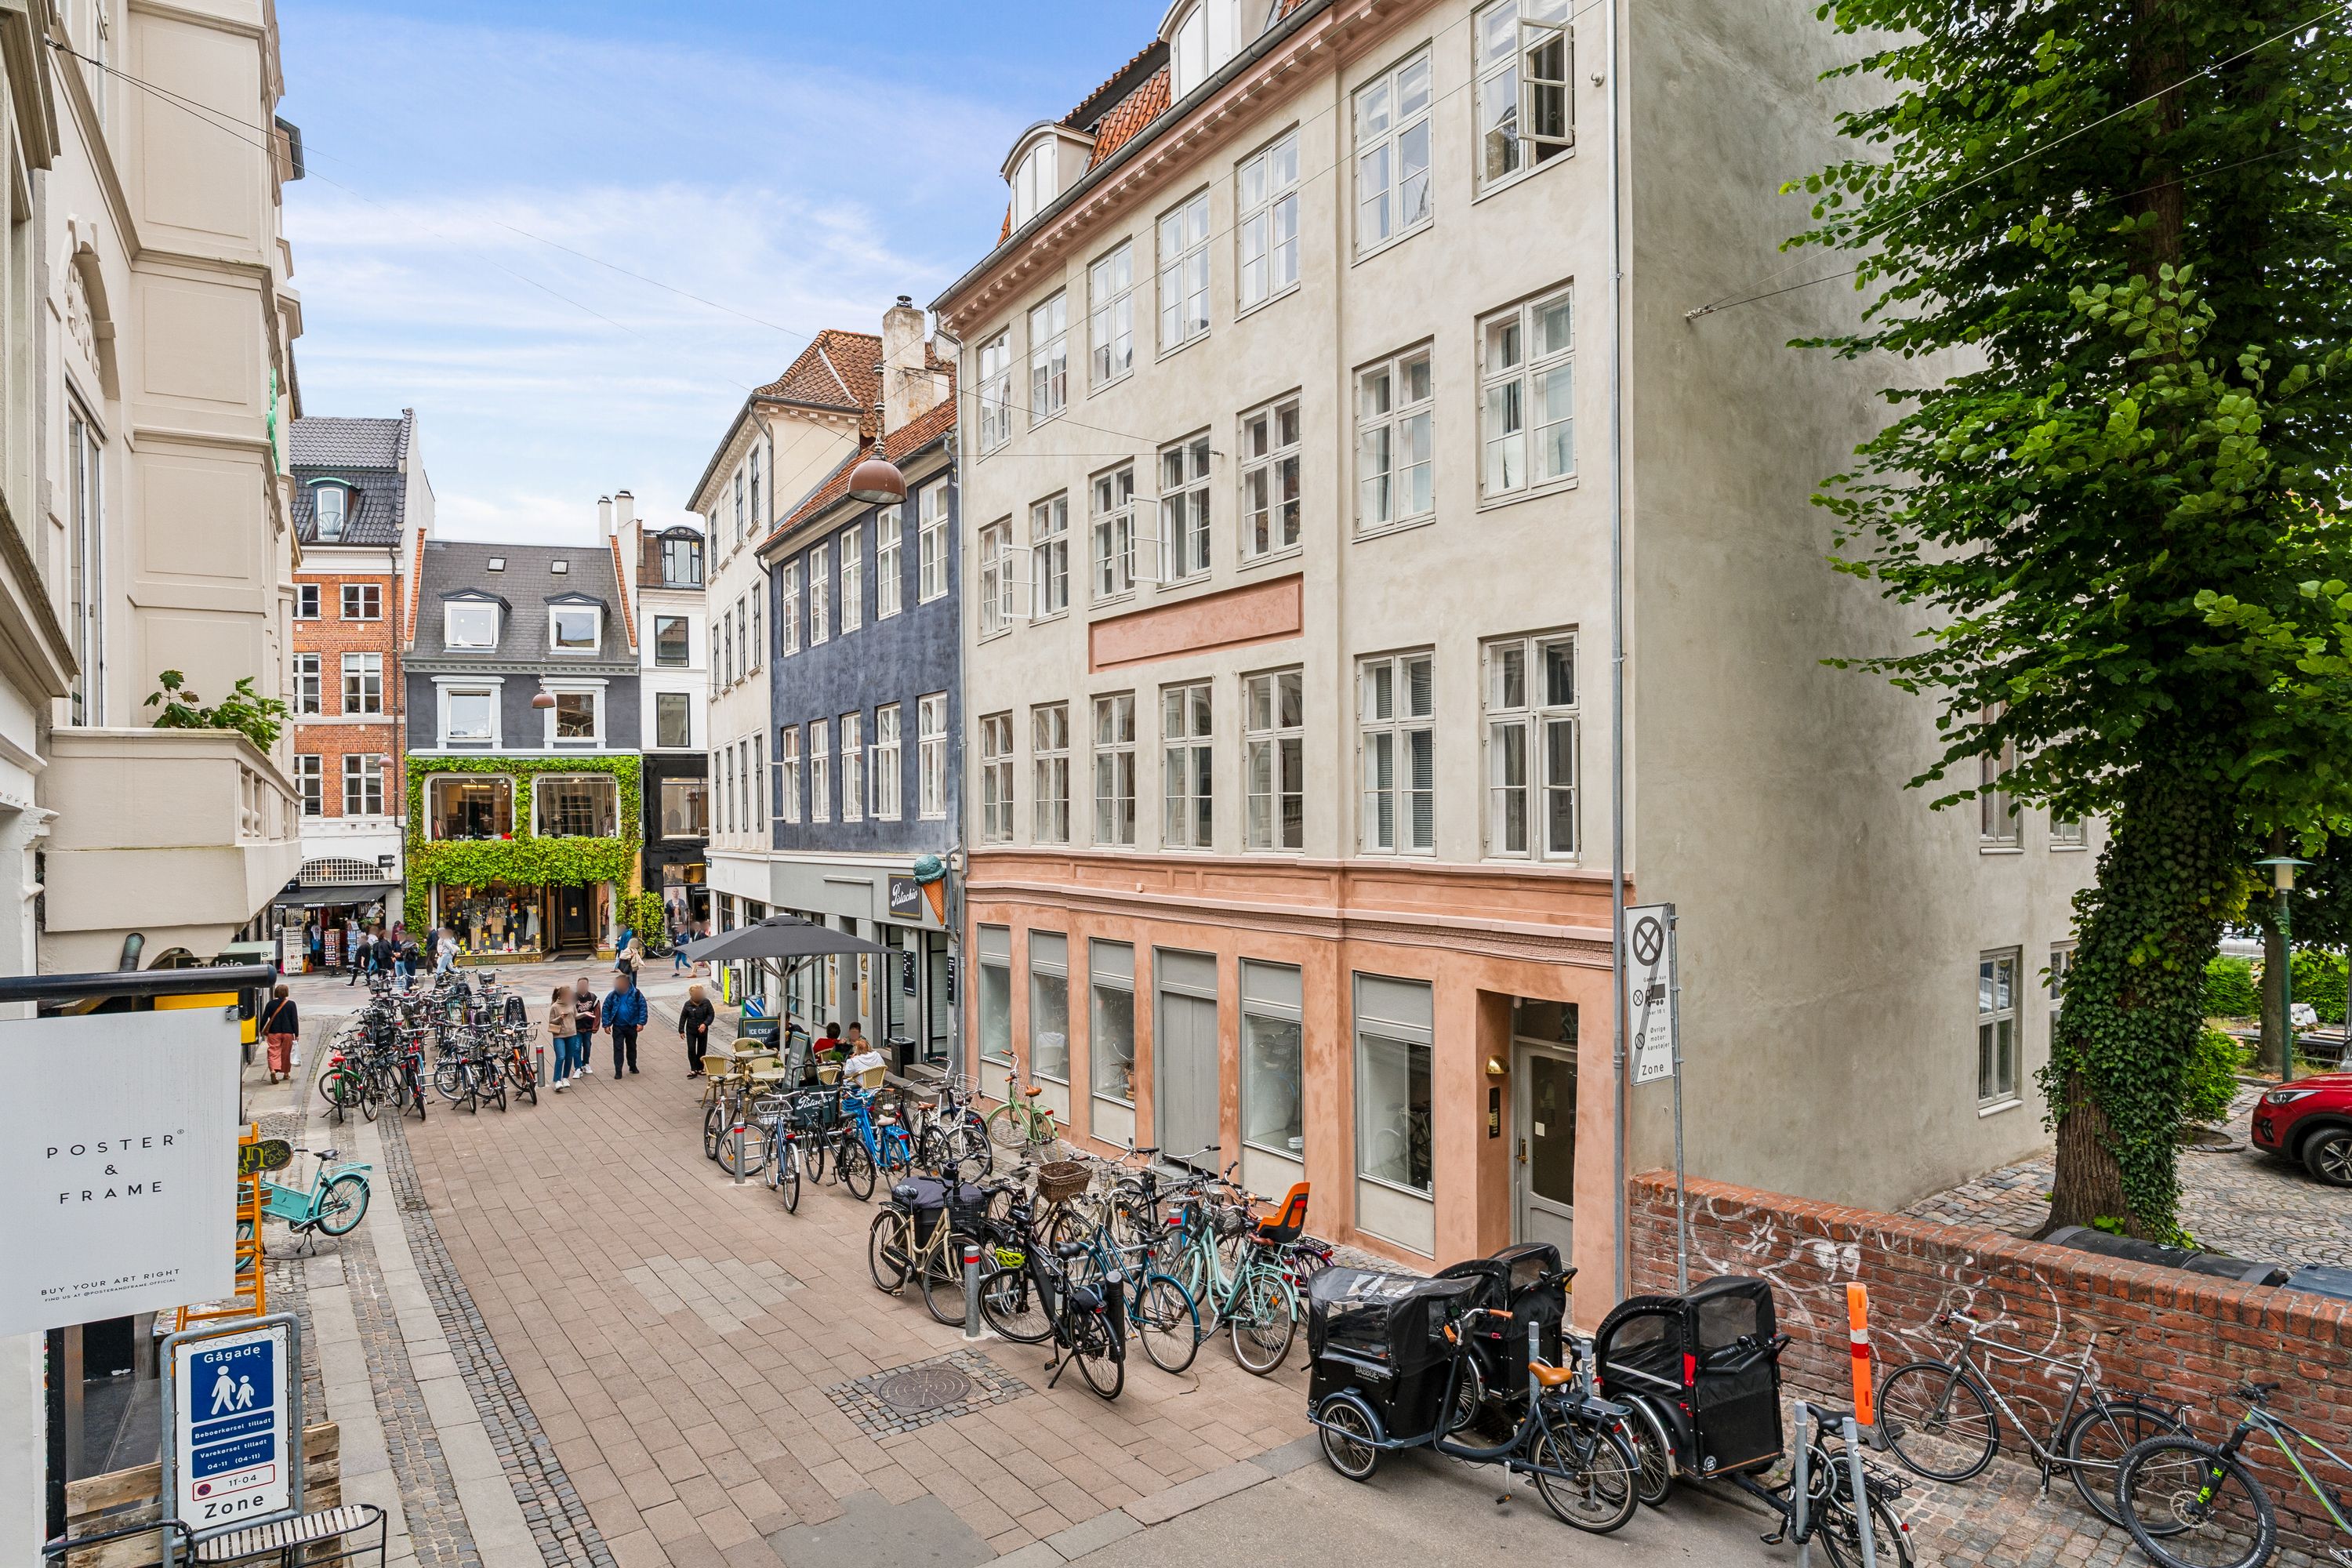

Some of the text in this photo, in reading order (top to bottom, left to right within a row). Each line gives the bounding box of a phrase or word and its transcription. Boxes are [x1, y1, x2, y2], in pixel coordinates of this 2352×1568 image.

[891, 882, 918, 907] Pistachio
[1648, 1042, 1670, 1051] køretøjer
[1642, 1064, 1664, 1076] Zone
[105, 1164, 118, 1175] &
[60, 1181, 162, 1204] FRAME
[41, 1269, 180, 1295] BUY YOUR ART RIGHT
[204, 1346, 260, 1363] Gågade
[1988, 1389, 2023, 1429] TREK
[194, 1417, 271, 1439] Beboerkørsel tilladt
[200, 1439, 267, 1458] Varekørsel tilladt
[207, 1453, 260, 1470] 04-11 (04-11)
[229, 1475, 256, 1486] 11-04
[205, 1495, 263, 1519] Zone
